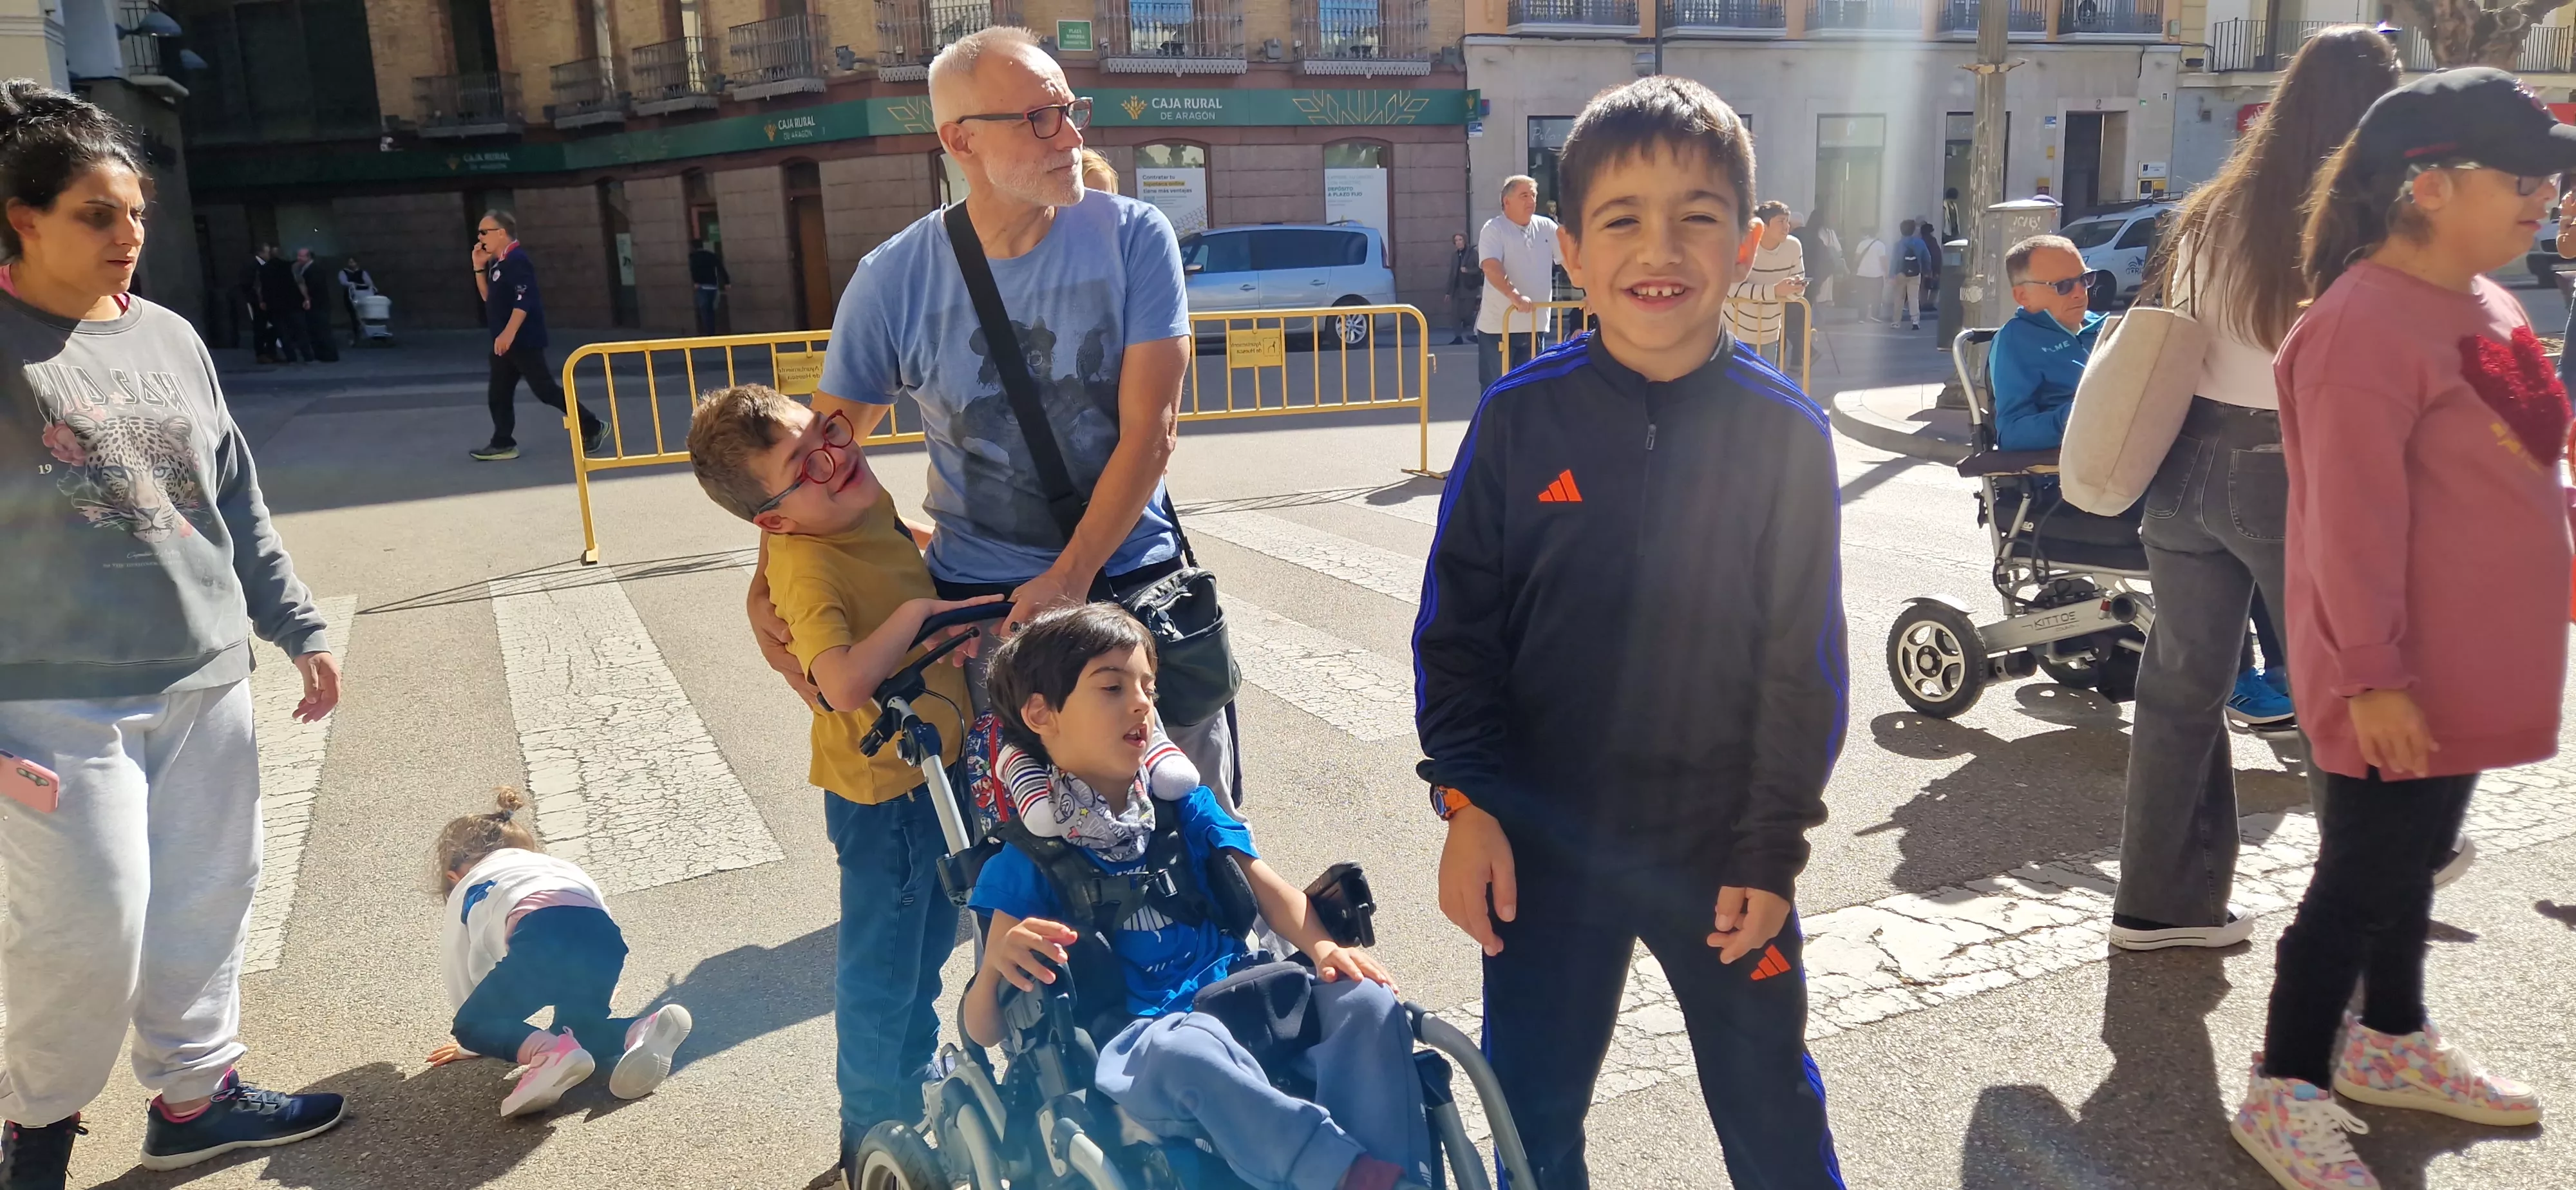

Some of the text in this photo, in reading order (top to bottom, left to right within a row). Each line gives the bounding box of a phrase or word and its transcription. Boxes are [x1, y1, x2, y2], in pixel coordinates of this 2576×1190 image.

[1151, 98, 1222, 109] CAJA RURAL
[2096, 99, 2101, 109] 2
[778, 116, 816, 129] CAJA RURAL
[39, 464, 52, 474] 19
